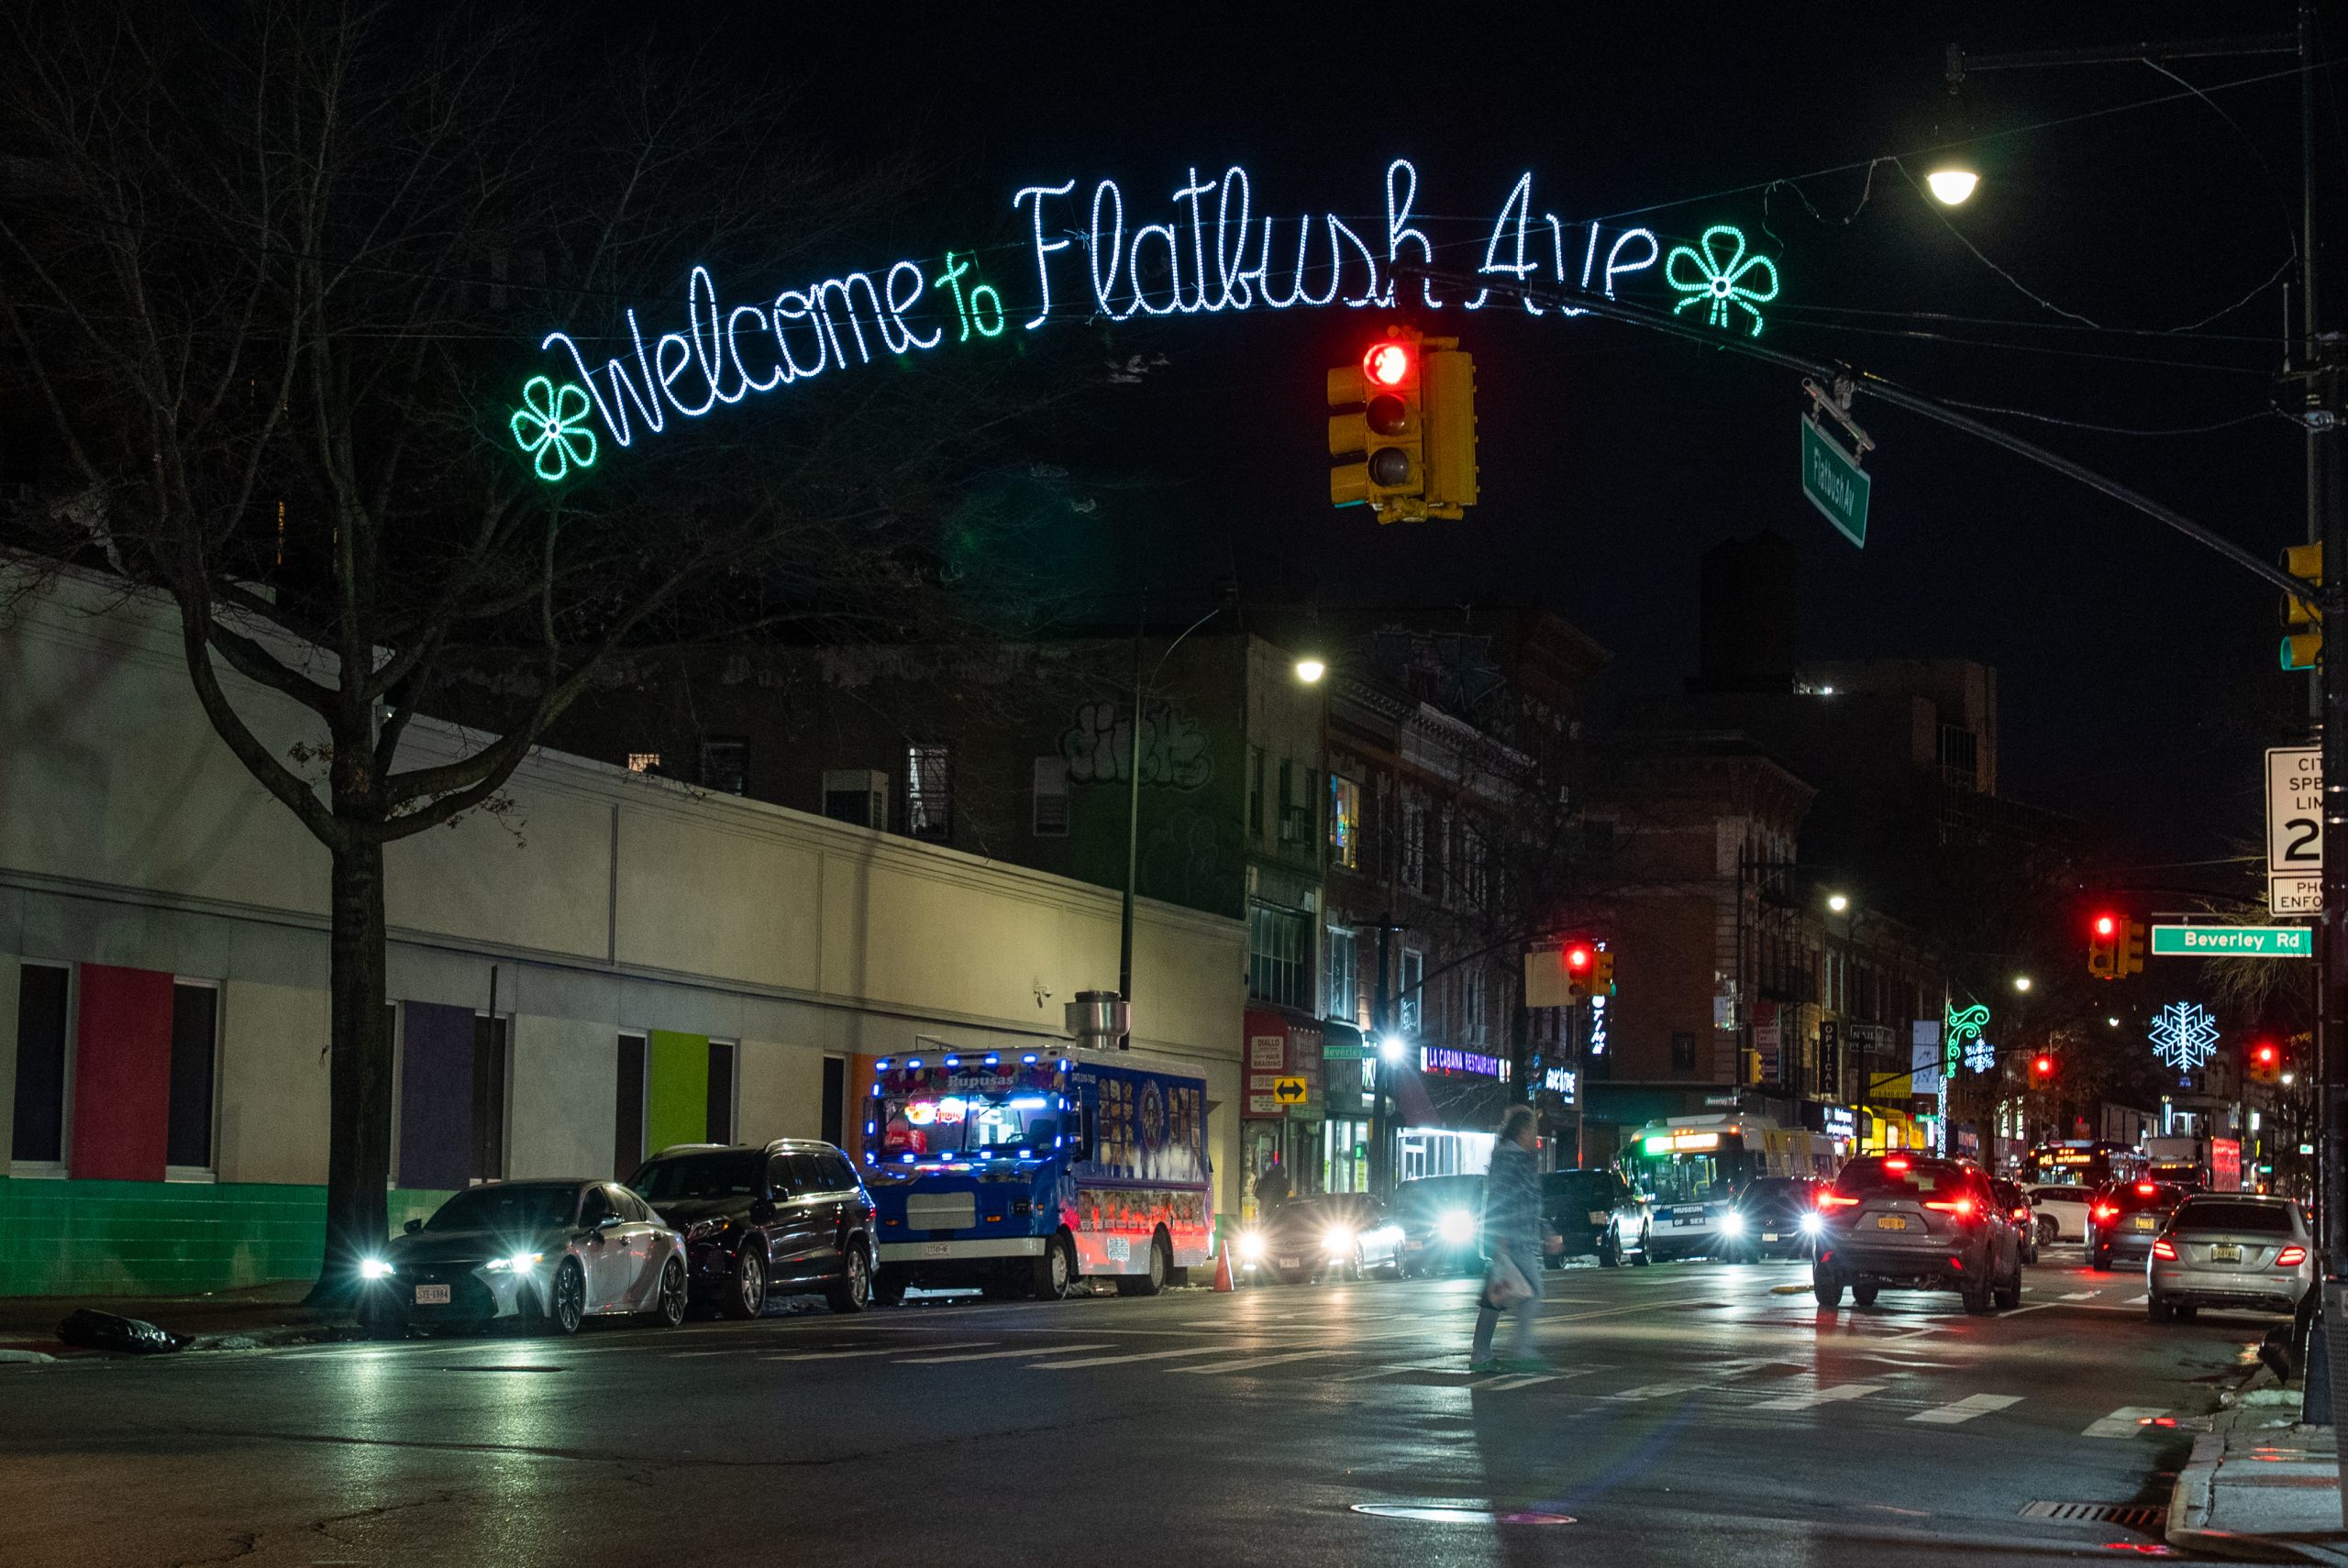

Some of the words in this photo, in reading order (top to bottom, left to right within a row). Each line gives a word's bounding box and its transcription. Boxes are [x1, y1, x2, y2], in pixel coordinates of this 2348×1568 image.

[542, 261, 941, 447] Welcome
[935, 250, 1004, 342] to
[1013, 158, 1443, 329] Flatbush
[1464, 171, 1658, 317] Ave
[1813, 447, 1844, 509] Flatbush
[1843, 479, 1855, 517] Av
[2298, 757, 2323, 771] CIT
[2289, 778, 2323, 791] SPE
[2297, 796, 2323, 810] LIM
[2285, 818, 2320, 861] 2
[2281, 896, 2323, 908] ENFO
[2184, 931, 2265, 951] Beverley
[2276, 933, 2299, 948] Rd
[1257, 1038, 1279, 1046] DIALLO
[1429, 1048, 1438, 1066] LA
[1439, 1049, 1463, 1070] CABANA
[1465, 1053, 1498, 1077] RESTAURANT
[1824, 1024, 1833, 1090] OPTICAL
[947, 1075, 1014, 1089] Pupusas
[1673, 1206, 1703, 1214] MUSEUM
[1689, 1217, 1704, 1225] SEX
